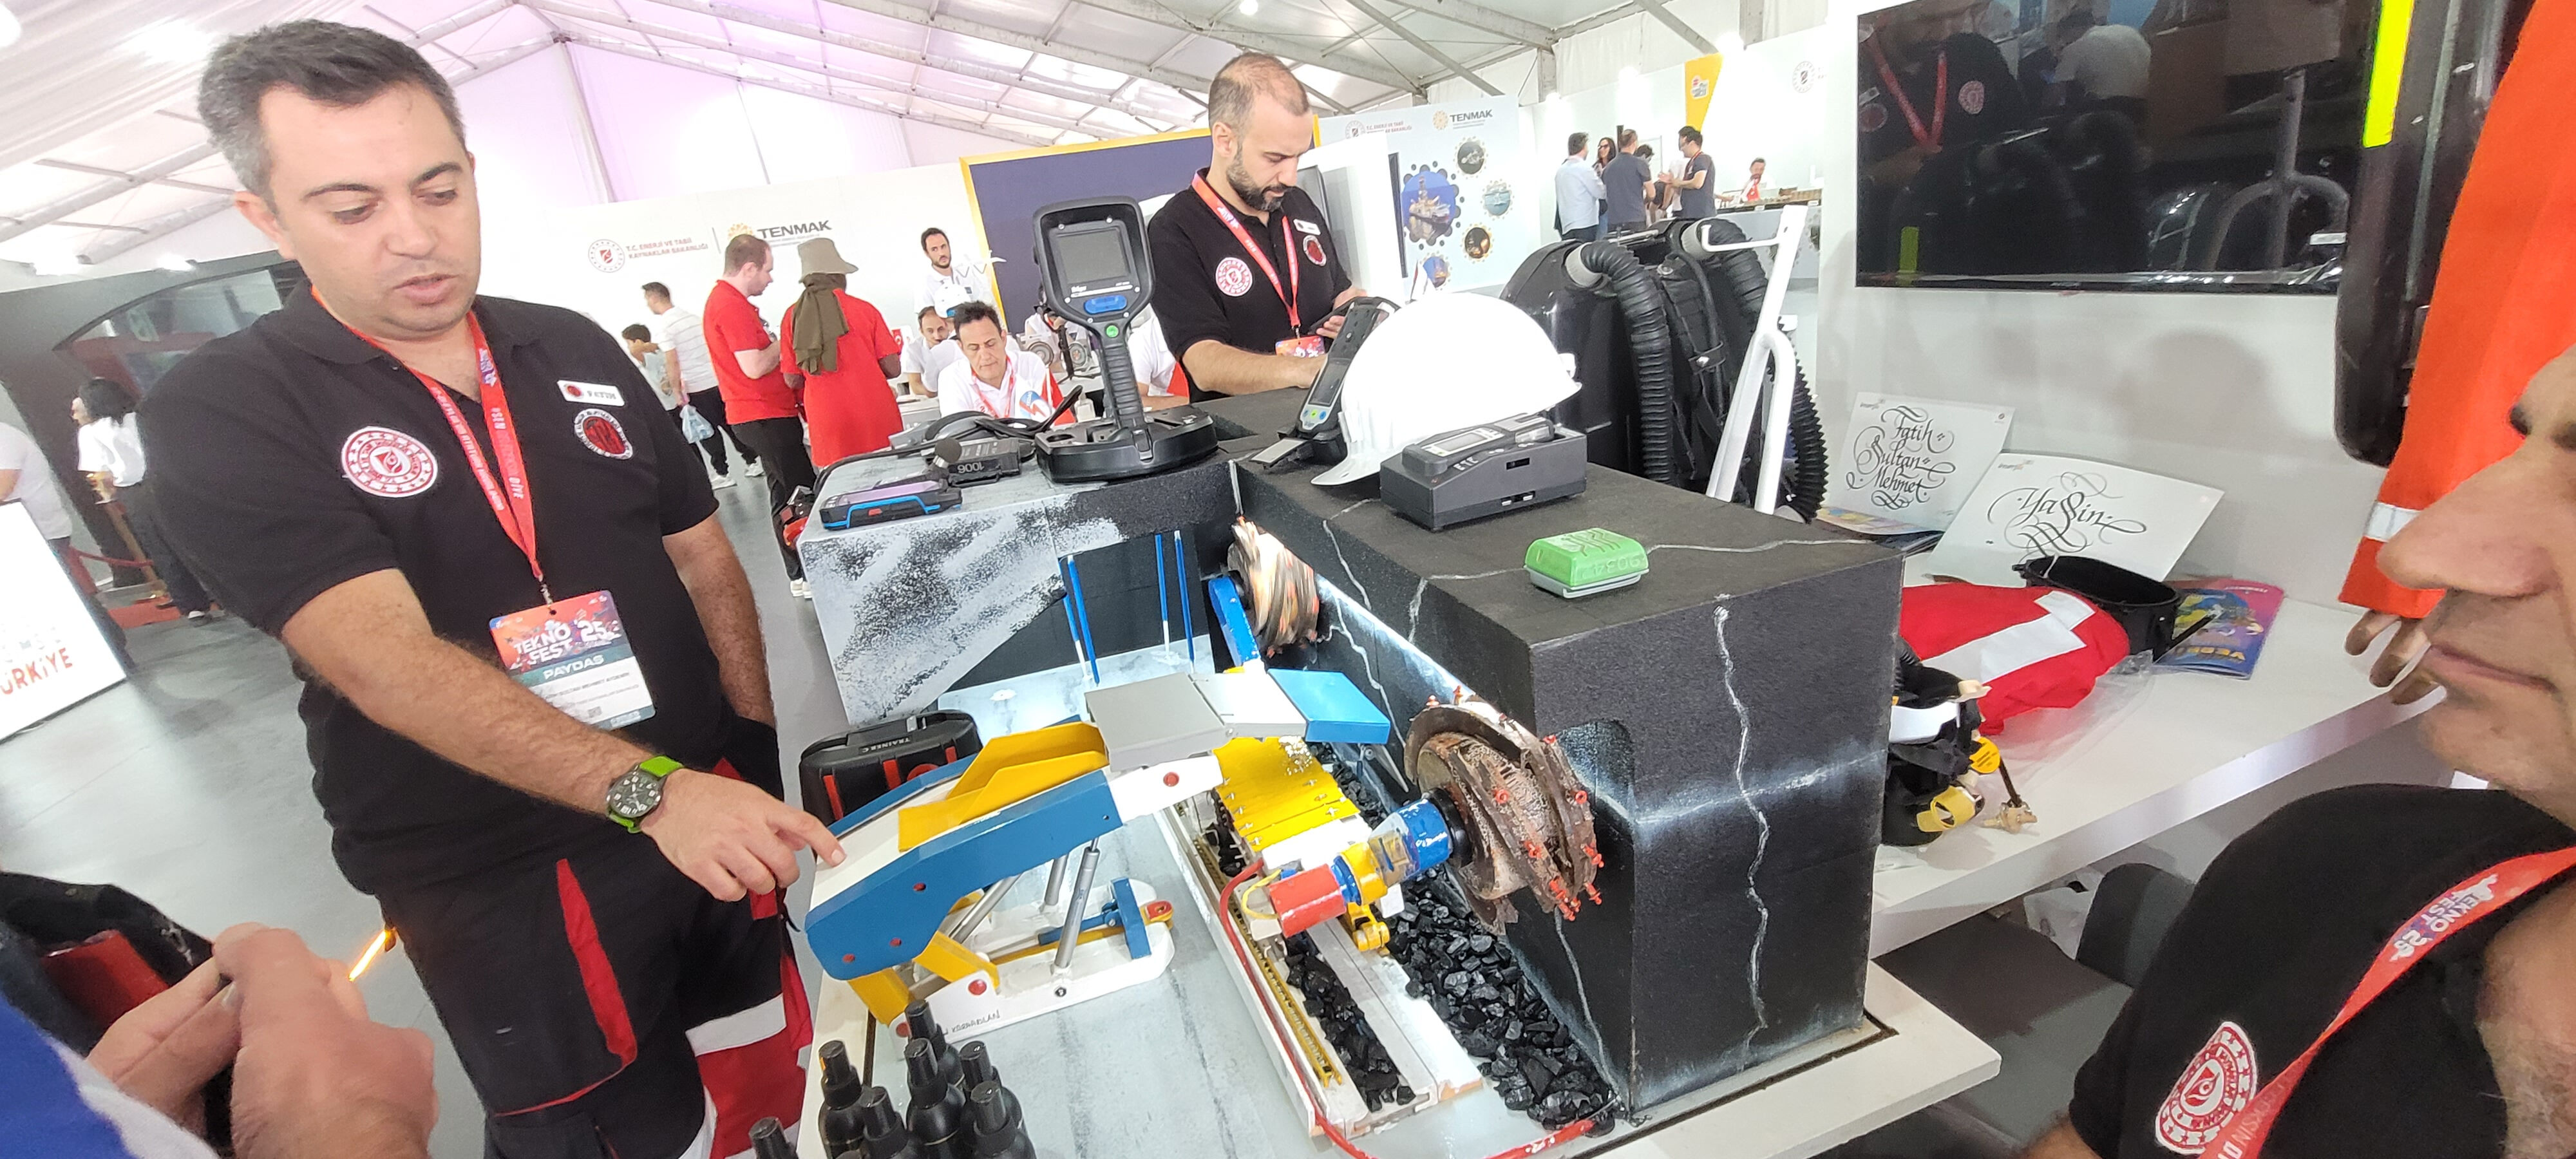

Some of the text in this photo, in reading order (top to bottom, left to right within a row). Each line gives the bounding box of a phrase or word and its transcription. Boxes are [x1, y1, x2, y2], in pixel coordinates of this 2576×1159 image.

[1450, 109, 1493, 122] TENMAK
[757, 220, 832, 239] TENMAK
[957, 462, 985, 474] 1006
[514, 619, 609, 654] TEKNO '25
[527, 637, 573, 665] FEST
